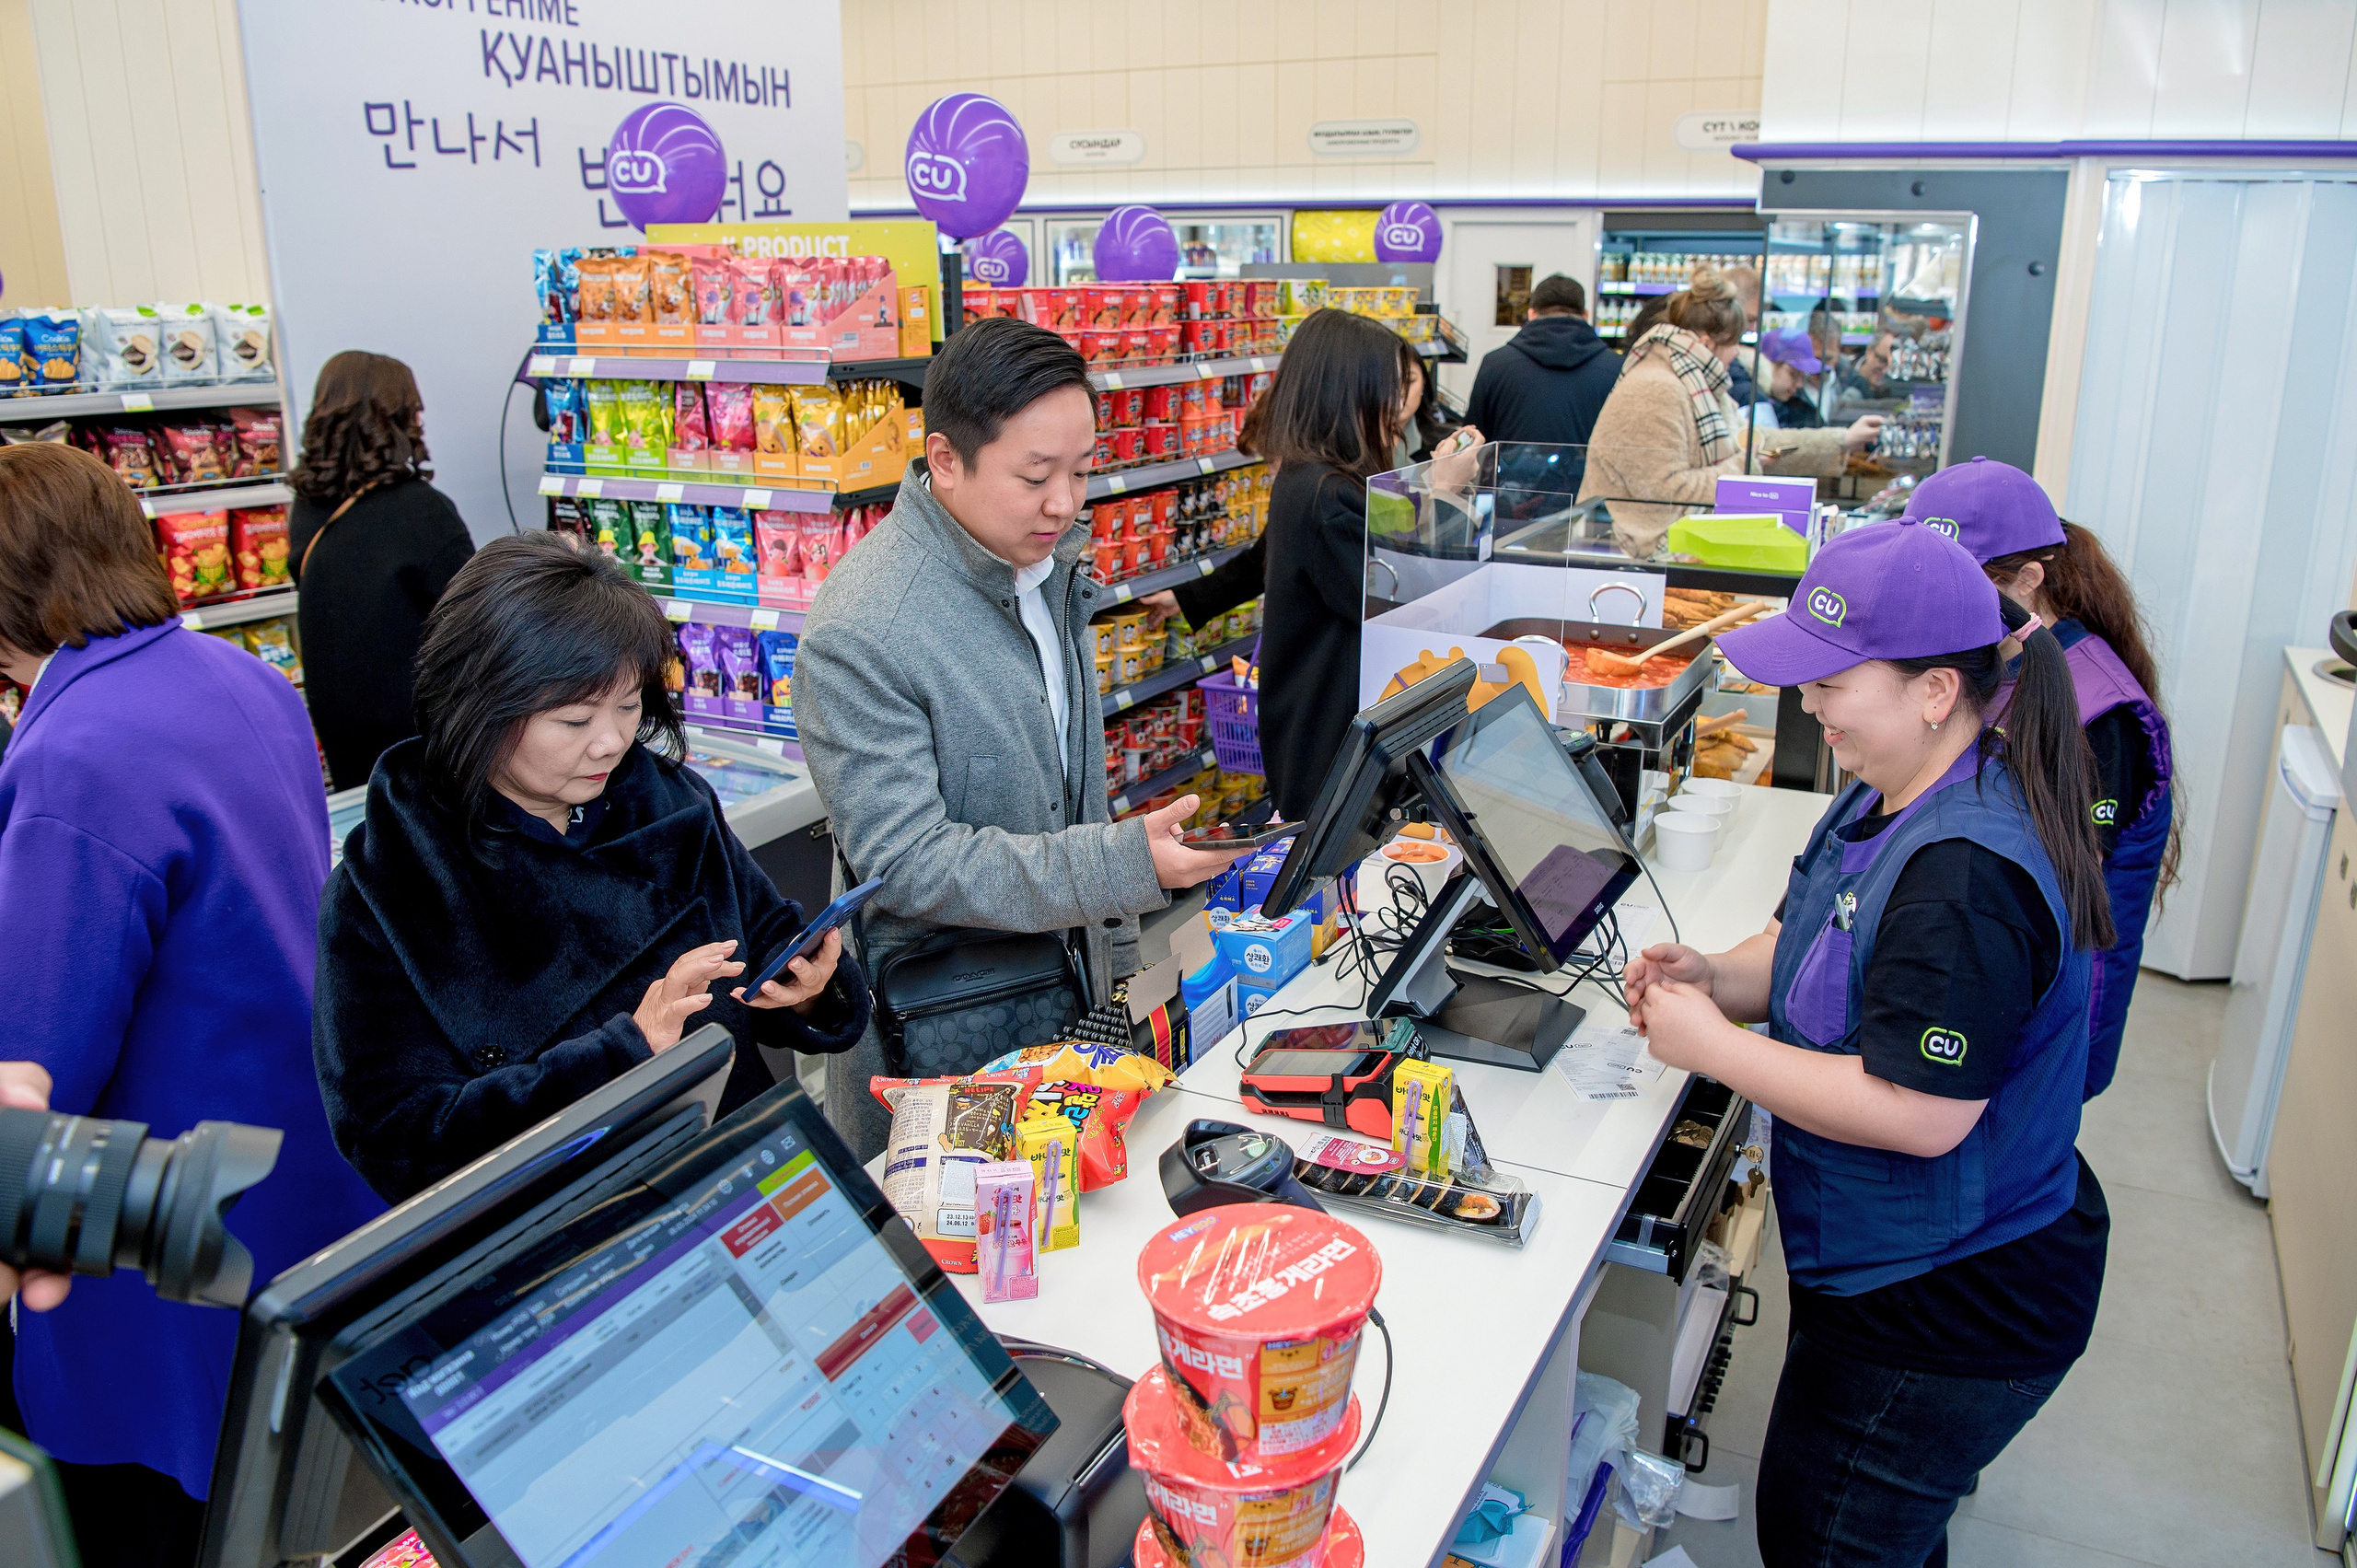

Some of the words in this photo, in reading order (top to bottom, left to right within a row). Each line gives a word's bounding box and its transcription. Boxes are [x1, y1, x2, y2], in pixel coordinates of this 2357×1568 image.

[481, 29, 792, 109] ҚУАНЫШТЫМЫН
[364, 100, 540, 168] 만나서
[1738, 120, 1759, 131] КО
[614, 161, 652, 184] CU
[913, 163, 952, 190] CU
[1390, 227, 1418, 244] CU
[981, 262, 1002, 277] CU
[1814, 593, 1840, 618] CU
[2095, 804, 2117, 820] CU
[1211, 913, 1231, 924] 상쾌환
[1246, 952, 1271, 966] 상쾌환
[1928, 1036, 1959, 1056] CU
[1030, 1147, 1072, 1162] 바맛
[1169, 1215, 1219, 1242] HEYROO
